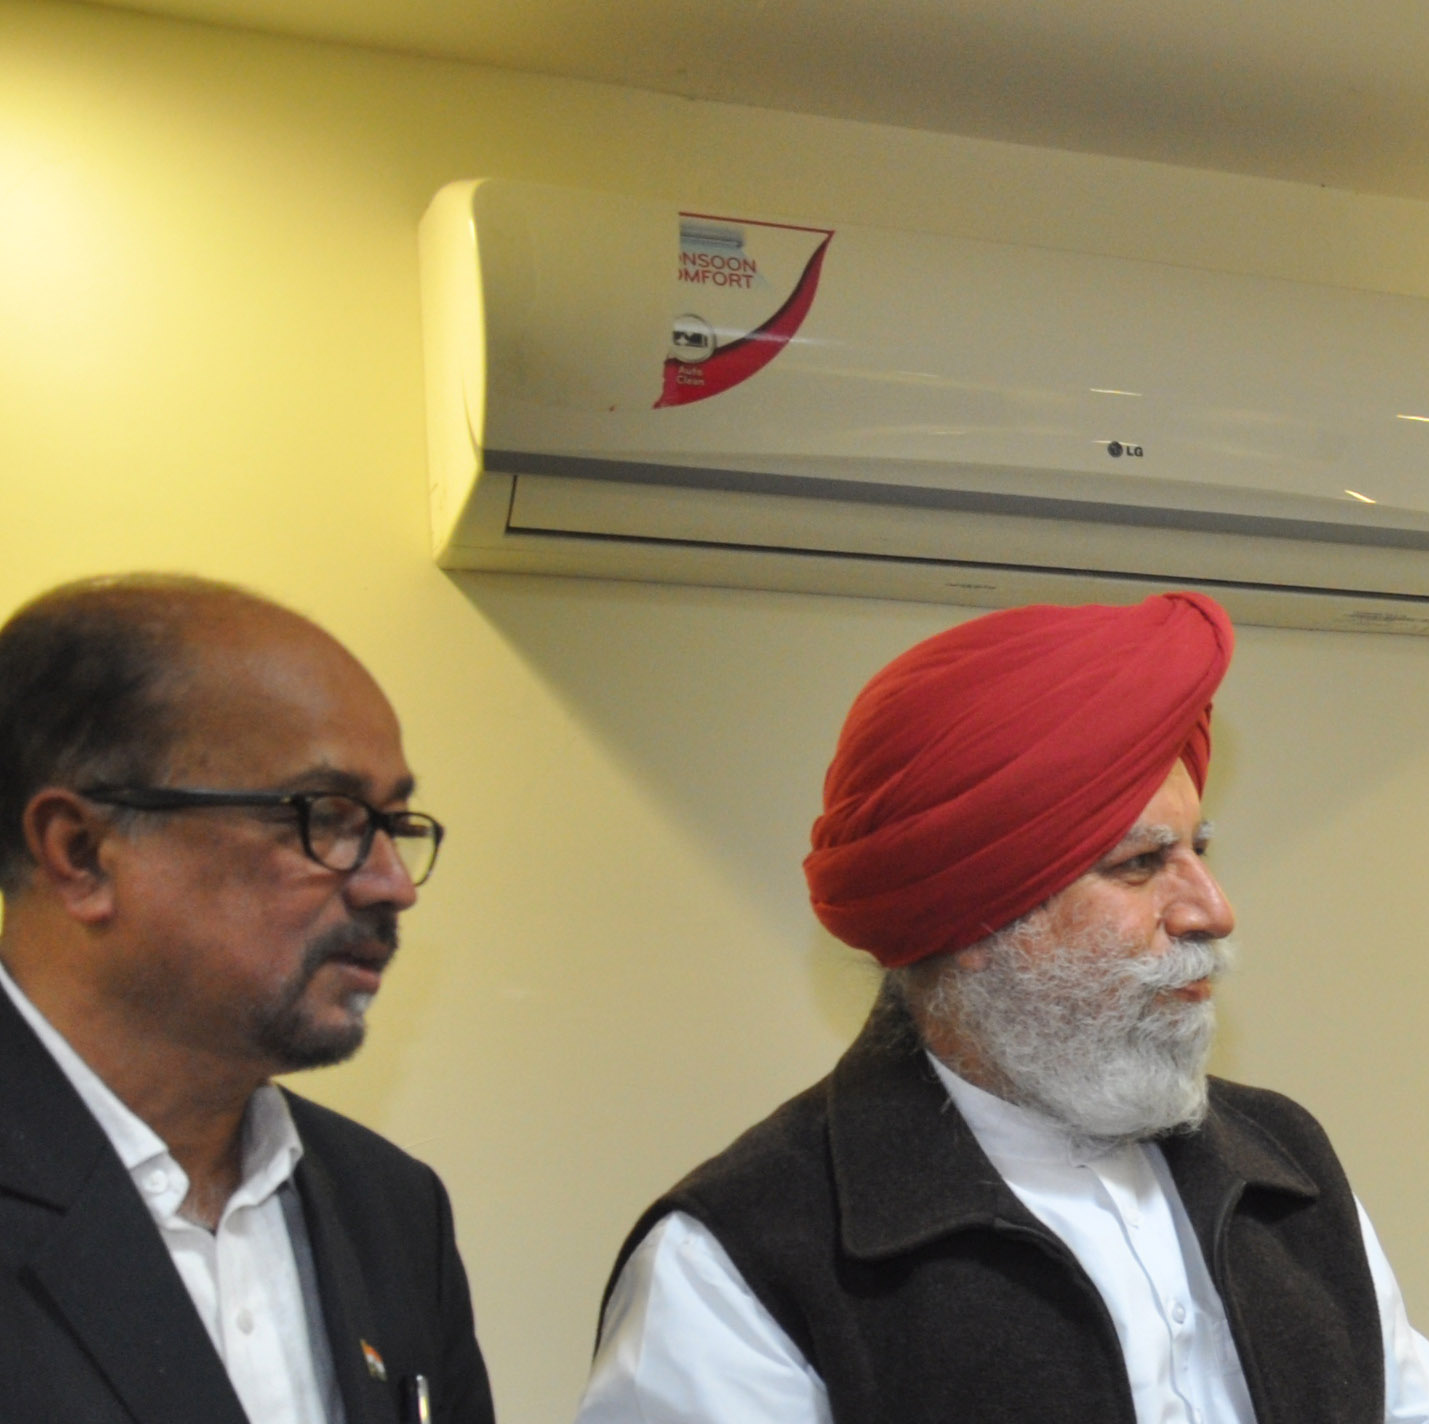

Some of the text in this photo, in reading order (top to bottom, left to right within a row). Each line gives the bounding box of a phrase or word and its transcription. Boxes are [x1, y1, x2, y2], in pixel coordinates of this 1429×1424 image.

[679, 252, 757, 274] NSOON
[678, 366, 703, 376] Auto
[677, 375, 705, 386] Clean
[1126, 446, 1144, 457] LG
